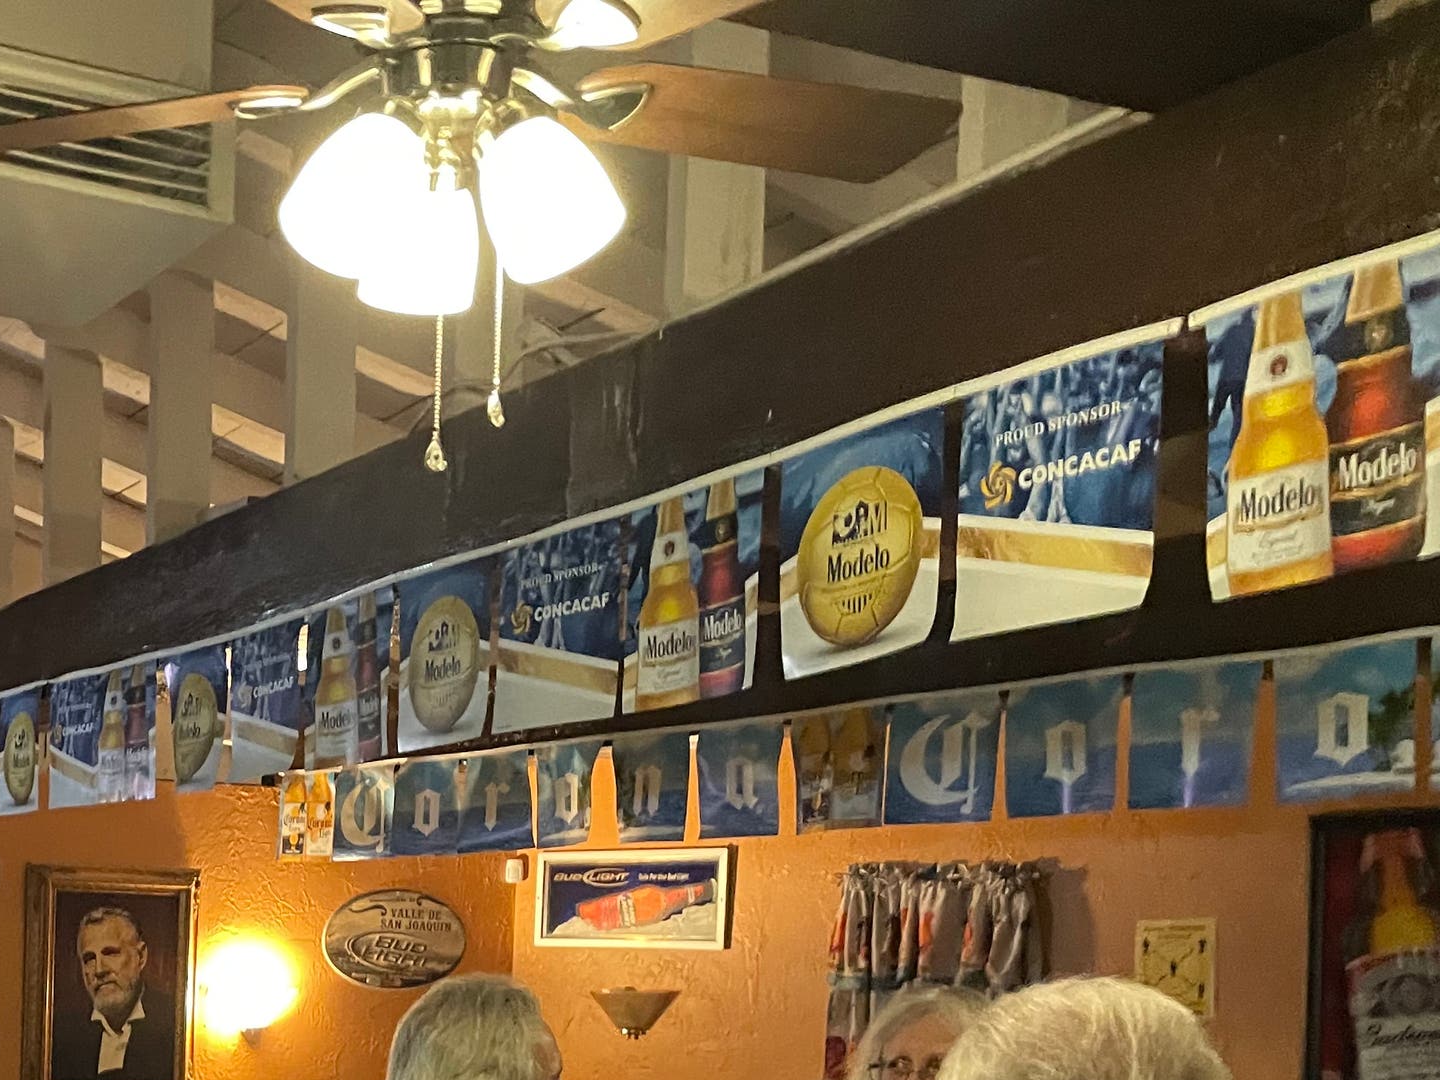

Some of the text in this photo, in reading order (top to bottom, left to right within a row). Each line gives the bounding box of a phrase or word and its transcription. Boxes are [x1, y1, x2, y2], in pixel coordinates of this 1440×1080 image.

[994, 400, 1122, 447] PROUD SPONSOR
[1018, 438, 1142, 489] CONCACAF
[1339, 441, 1418, 489] Modelo
[1239, 477, 1316, 522] Modelo
[827, 543, 890, 583] Modelo
[534, 591, 611, 622] CONCACAF
[704, 610, 743, 641] Modelo
[646, 630, 694, 660] Modelo
[424, 655, 460, 684] Modelo
[553, 871, 584, 882] BUD
[589, 870, 630, 882] LIGHT
[380, 919, 452, 932] SAN JOAQUIN
[390, 907, 441, 920] VALLE DE
[375, 935, 428, 954] BUD
